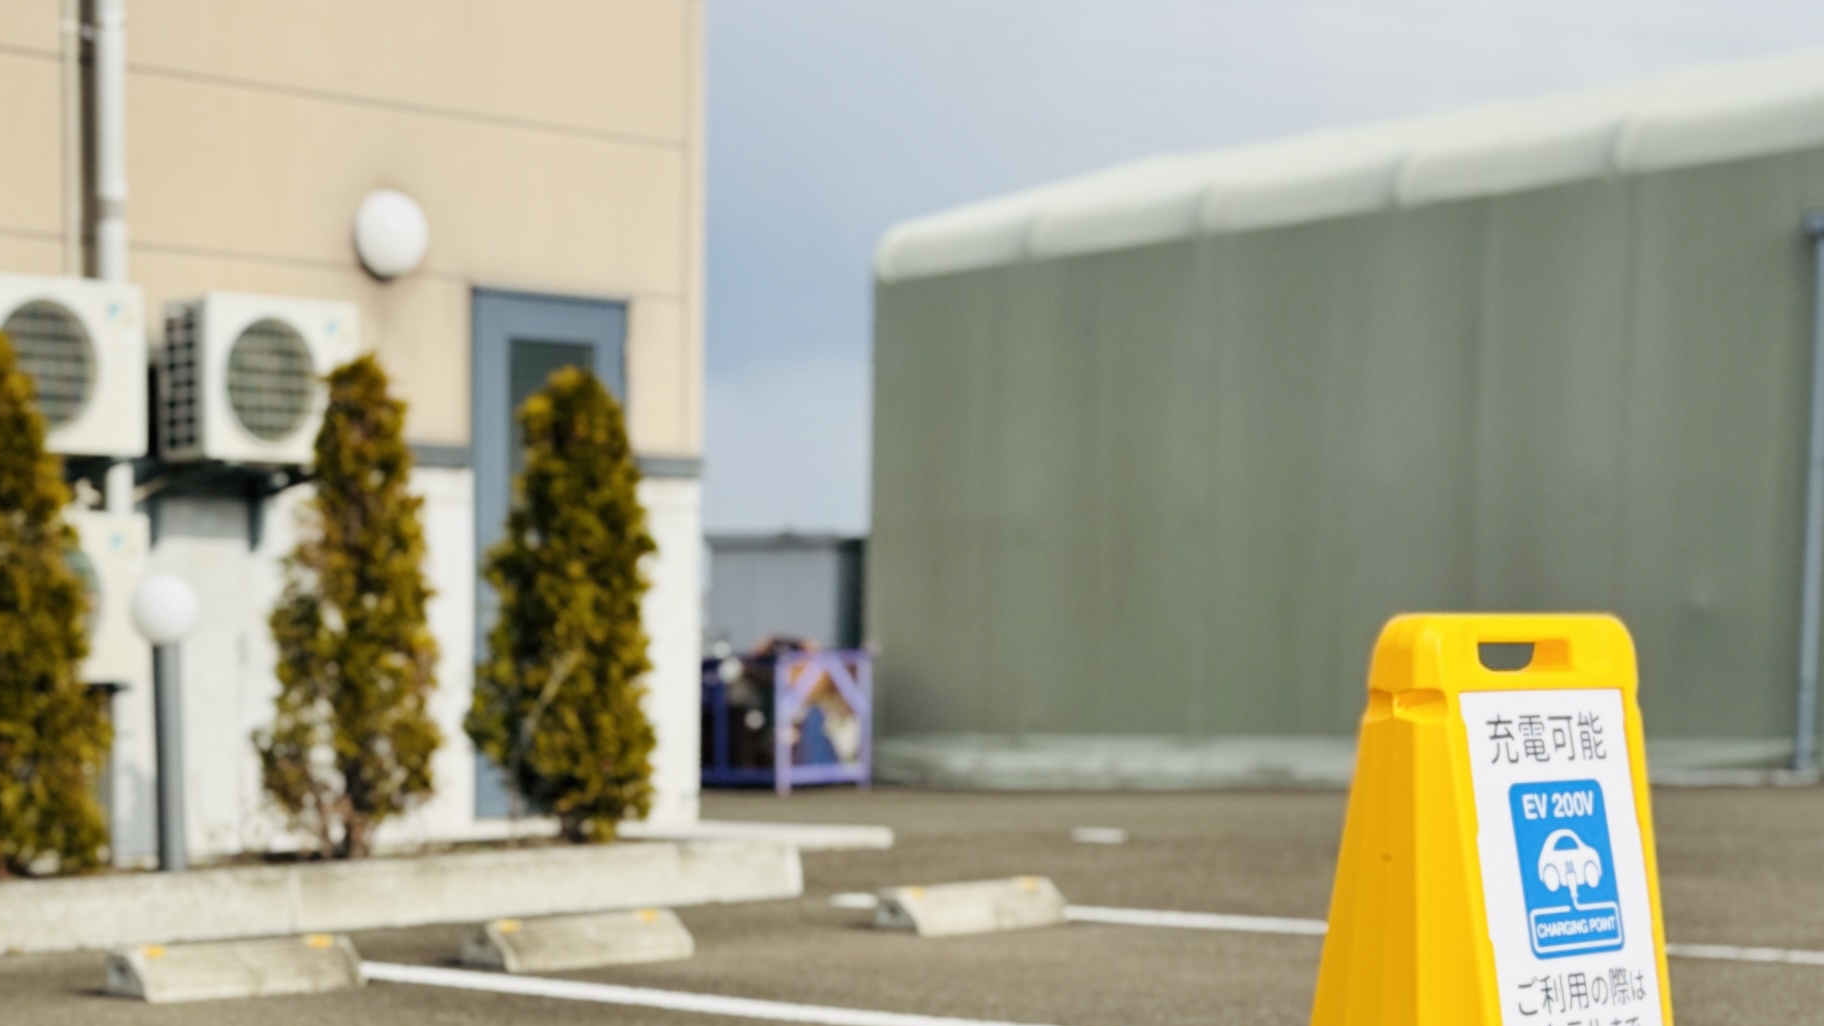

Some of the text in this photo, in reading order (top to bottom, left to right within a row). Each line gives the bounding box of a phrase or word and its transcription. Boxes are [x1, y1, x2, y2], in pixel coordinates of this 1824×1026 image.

[1486, 712, 1607, 764] 充電可能
[1522, 790, 1594, 820] EV 200V
[1537, 915, 1616, 938] CHARGING POINT
[1517, 967, 1647, 1016] ご利用の際は
